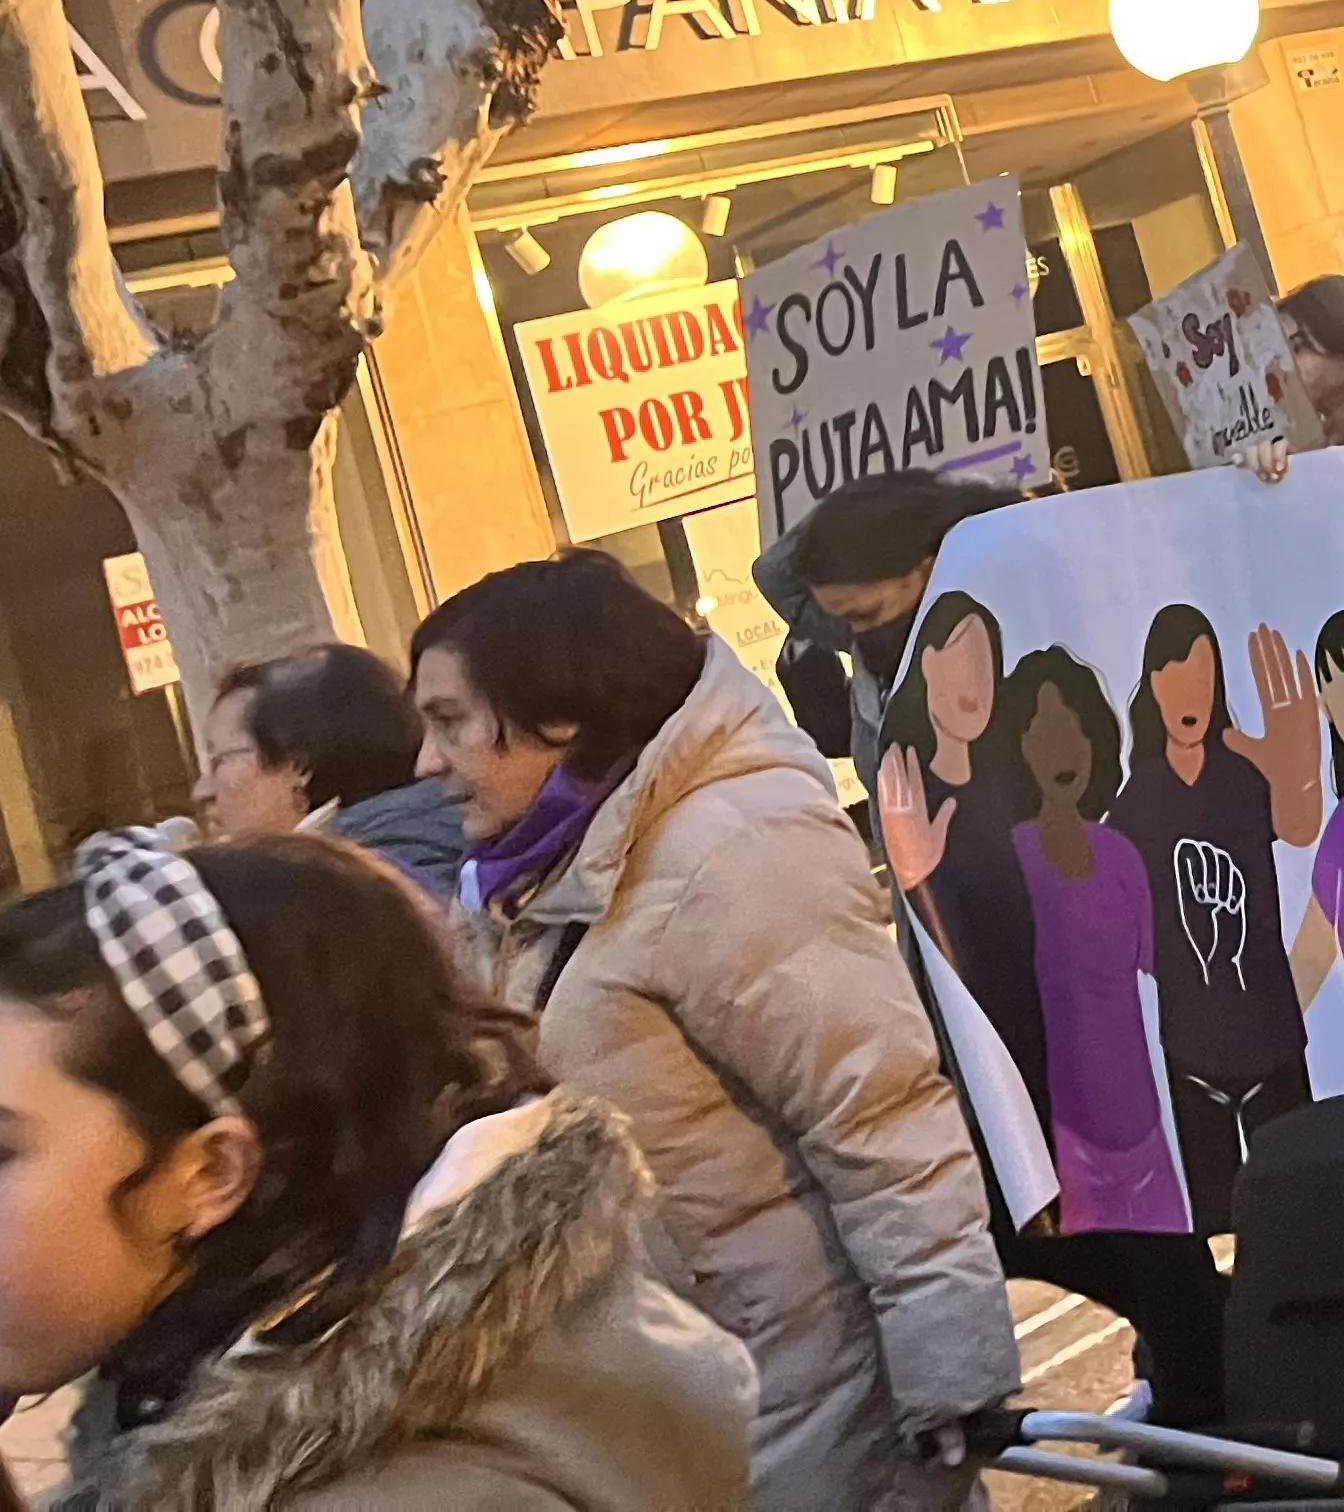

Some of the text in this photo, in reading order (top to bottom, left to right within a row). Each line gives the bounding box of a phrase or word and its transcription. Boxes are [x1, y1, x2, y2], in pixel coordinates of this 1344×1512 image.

[772, 239, 984, 394] SOY LA
[598, 390, 713, 463] POR
[630, 453, 718, 508] Gracias
[769, 347, 1037, 532] PUTA AMA!
